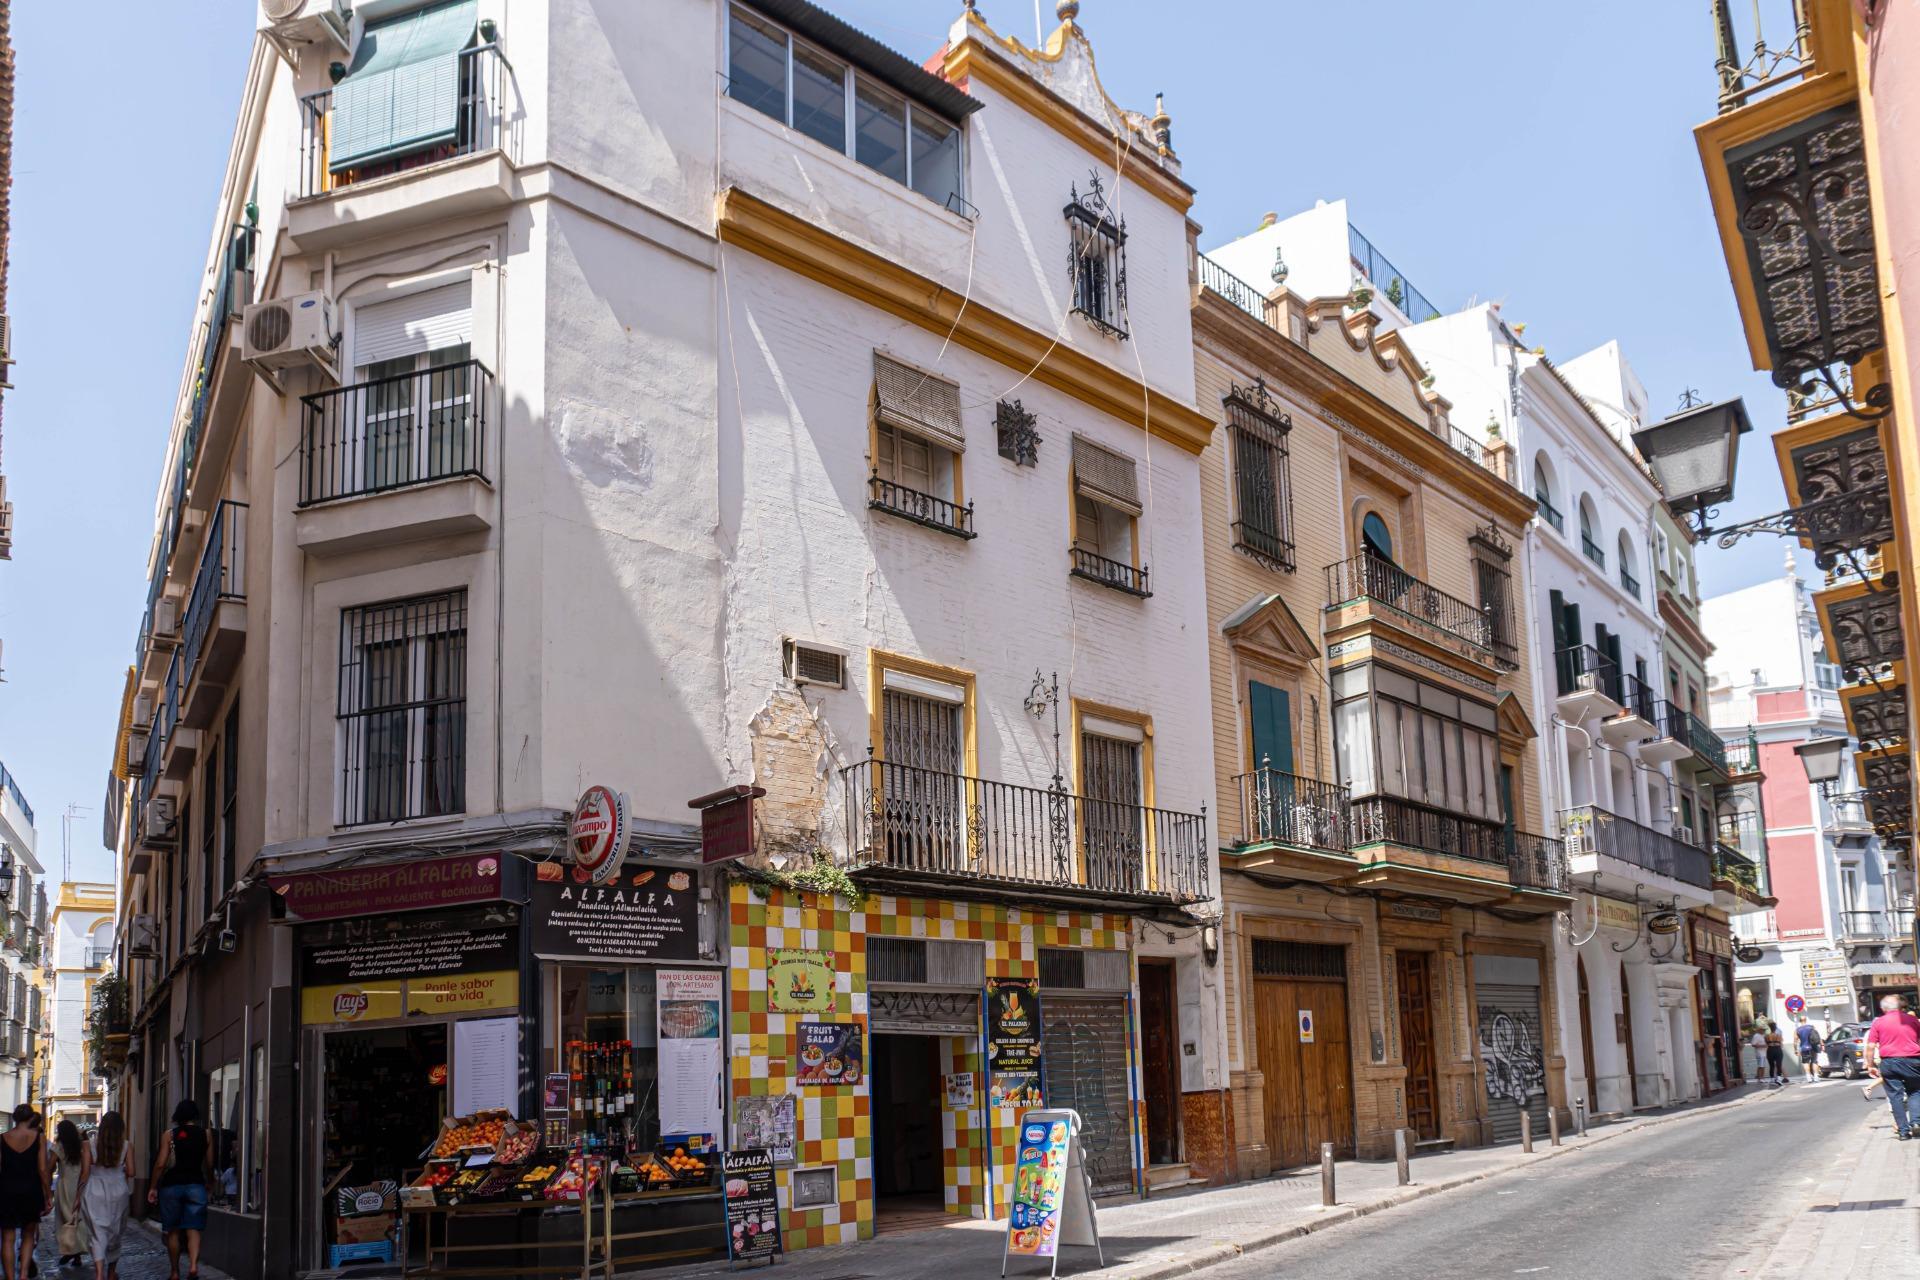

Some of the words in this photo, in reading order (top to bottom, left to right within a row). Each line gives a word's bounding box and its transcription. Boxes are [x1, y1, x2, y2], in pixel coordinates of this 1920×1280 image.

[396, 862, 473, 887] ALFALFA
[441, 884, 494, 898] BOCADILLOS
[560, 886, 674, 906] ALFALFA
[417, 963, 437, 972] Para
[425, 981, 457, 992] Ponle
[460, 978, 494, 990] sabor
[435, 994, 443, 1003] a
[446, 990, 456, 1002] la
[459, 990, 484, 1001] vida
[808, 1026, 833, 1035] FRUIT
